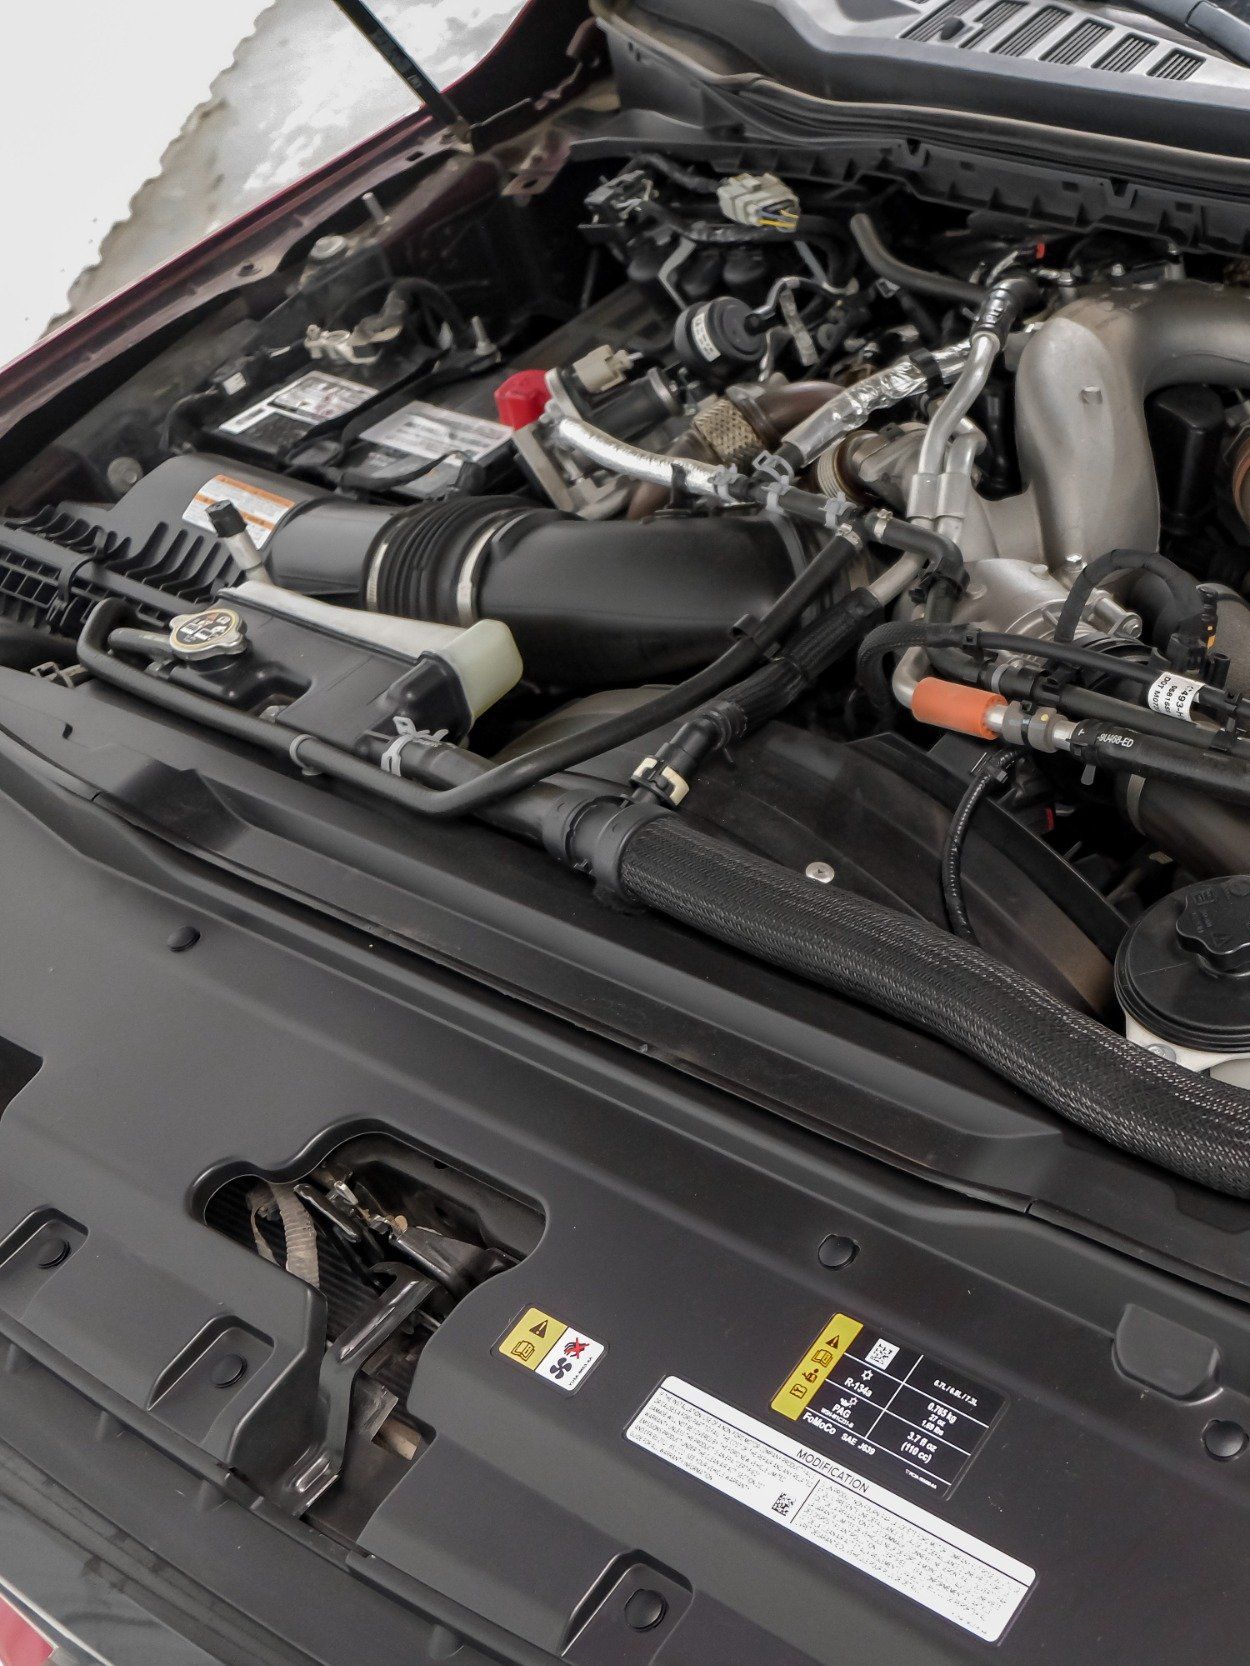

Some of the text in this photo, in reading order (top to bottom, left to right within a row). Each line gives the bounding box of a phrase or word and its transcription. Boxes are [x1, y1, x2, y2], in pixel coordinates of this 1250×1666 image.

[844, 1377, 873, 1397] R-134a
[831, 1403, 852, 1419] PAG
[802, 1411, 876, 1456] FoMoCo SAE J639
[907, 1431, 920, 1443] 3.7
[900, 1441, 932, 1464] (110 cc)
[796, 1449, 868, 1492] MODIFICATION
